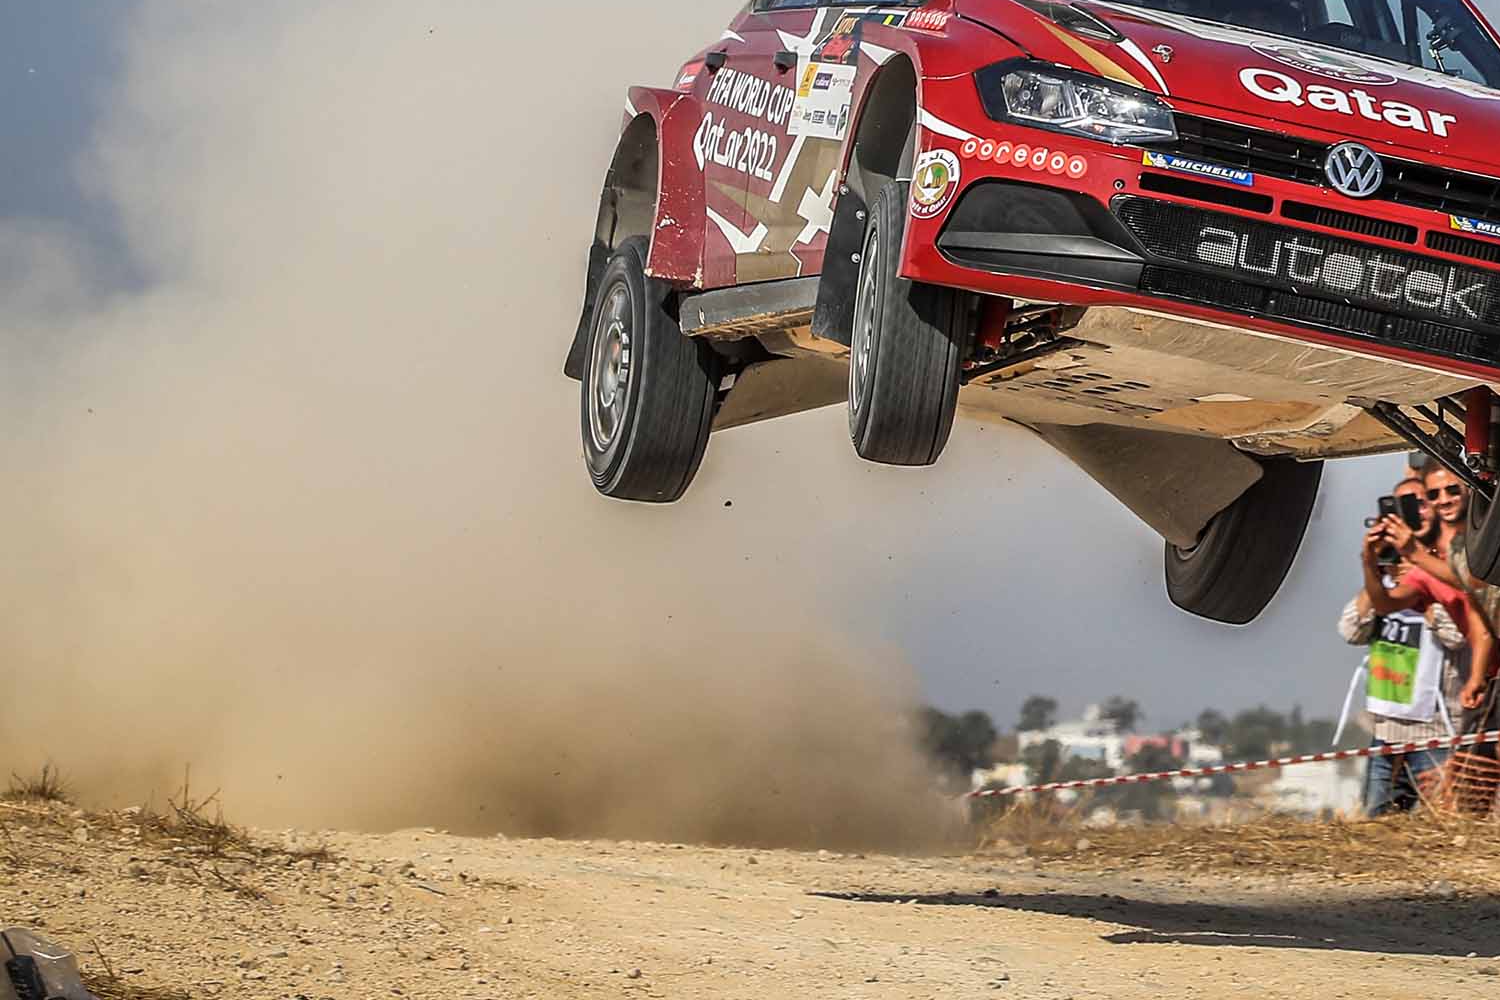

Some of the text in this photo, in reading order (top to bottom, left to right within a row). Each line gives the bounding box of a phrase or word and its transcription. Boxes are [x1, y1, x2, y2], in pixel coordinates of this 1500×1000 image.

[706, 67, 737, 109] FIFA
[733, 72, 771, 118] WORLD
[767, 84, 796, 126] CUP
[1237, 66, 1458, 138] Qatar
[736, 127, 777, 182] 2022
[963, 140, 1085, 175] ooredoo
[1170, 158, 1248, 180] MICHELIN
[1327, 142, 1384, 198] VW
[1196, 225, 1485, 320] autotek
